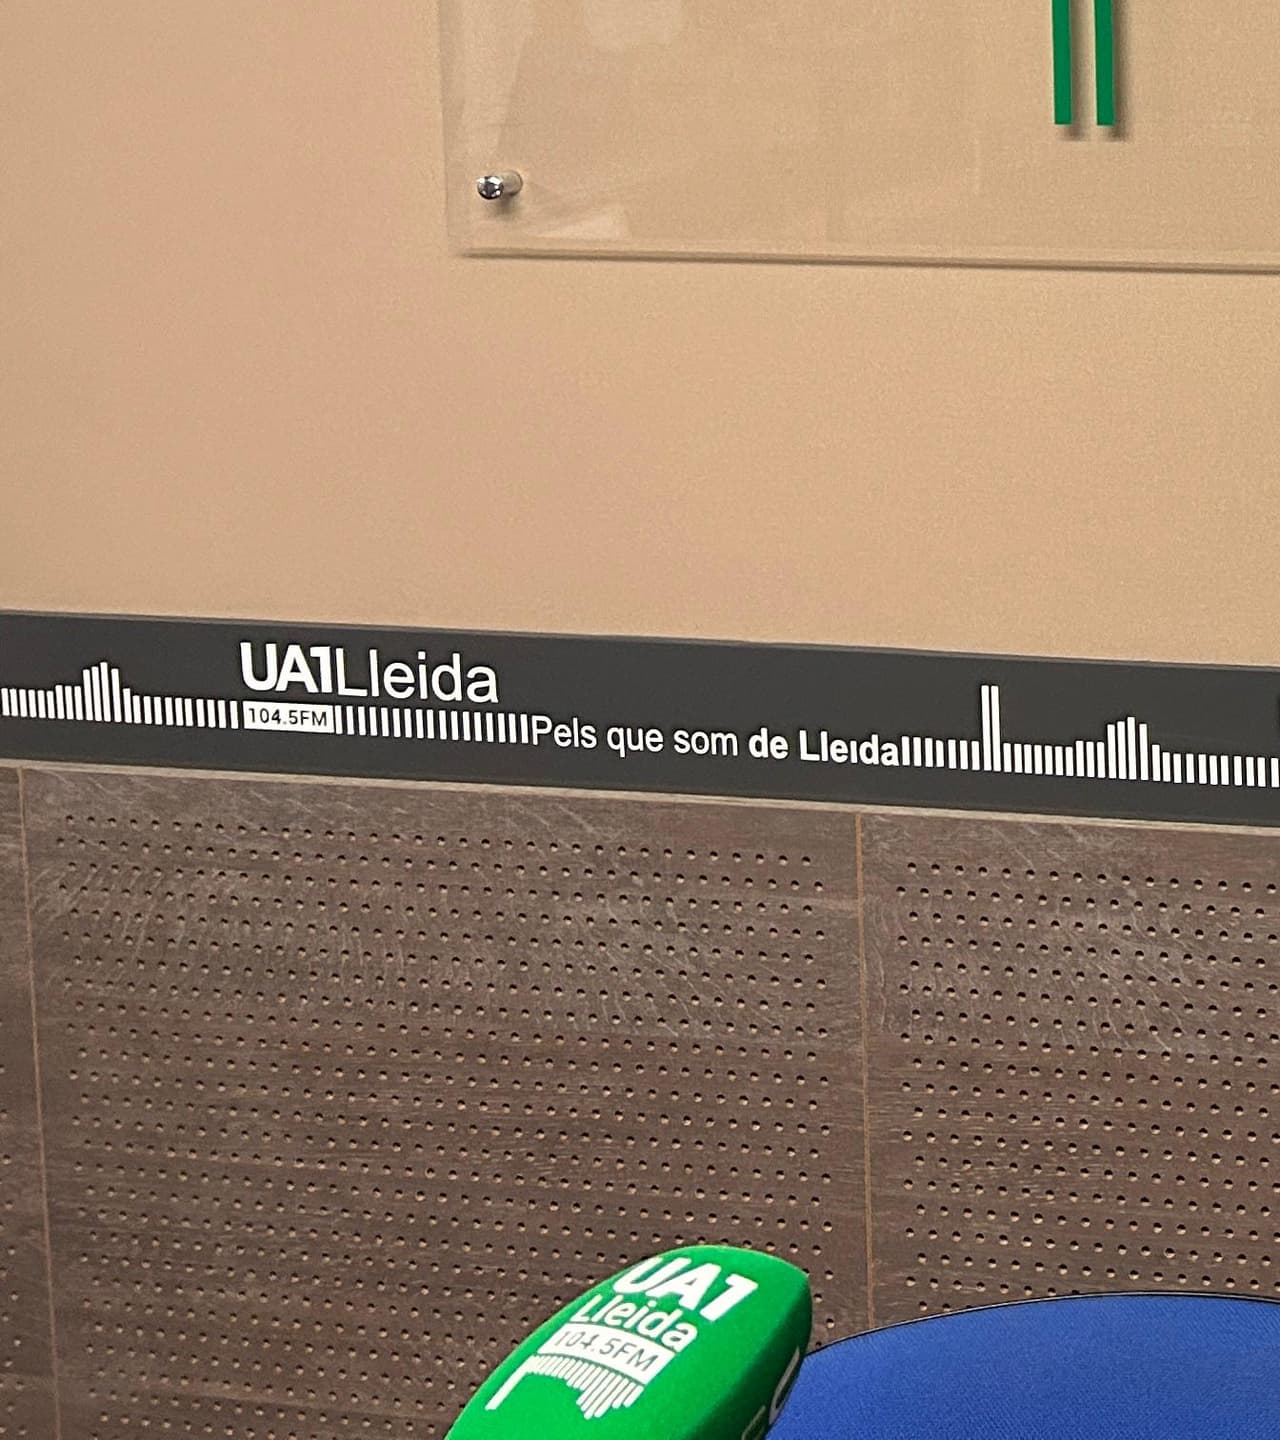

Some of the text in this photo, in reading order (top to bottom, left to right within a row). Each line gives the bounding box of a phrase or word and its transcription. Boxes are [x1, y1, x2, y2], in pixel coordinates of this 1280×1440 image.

[248, 708, 328, 727] 104.5FM
[531, 715, 598, 749] Pels
[606, 726, 664, 758] que
[673, 728, 738, 757] som
[748, 727, 789, 760] de
[612, 1256, 760, 1322] UA1
[568, 1293, 699, 1354] Lleida
[553, 1329, 660, 1373] 104.5FM
